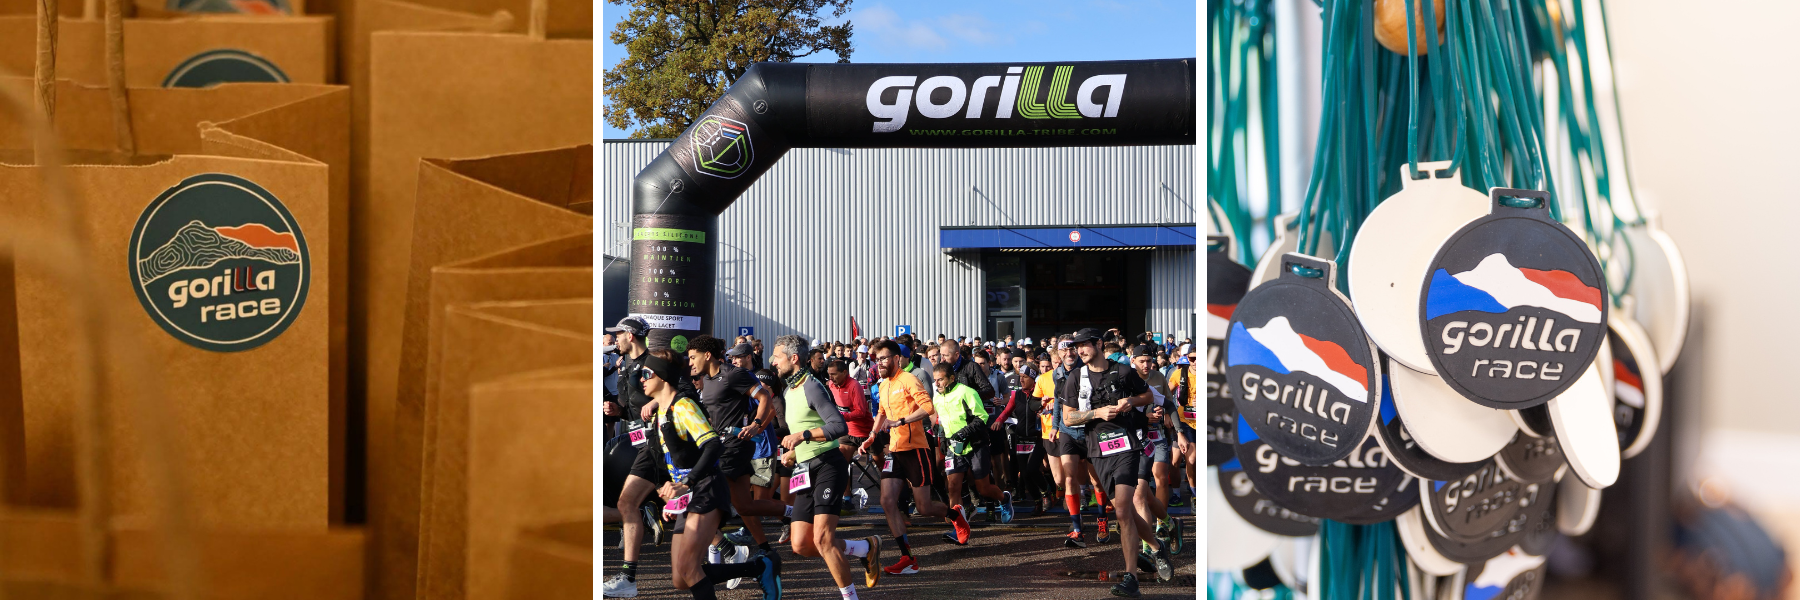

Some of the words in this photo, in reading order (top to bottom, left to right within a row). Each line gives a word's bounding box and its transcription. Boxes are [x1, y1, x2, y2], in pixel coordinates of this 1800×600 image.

[866, 66, 1127, 133] gorilla
[909, 128, 1117, 137] WWW.GORILLA-TRIBE.COM
[663, 231, 698, 240] SILICONE
[643, 254, 691, 262] MAINTIEN
[168, 265, 275, 308] gorilla
[642, 277, 686, 285] CONFORT
[632, 299, 695, 308] COMPRESSION
[201, 298, 281, 323] race
[741, 328, 749, 336] P
[898, 326, 906, 337] P
[1442, 315, 1582, 355] gorilla
[1471, 358, 1564, 381] race
[1241, 371, 1352, 425] gorilla
[1266, 411, 1339, 448] race
[1107, 439, 1121, 450] 65
[792, 475, 805, 488] 174
[1287, 475, 1378, 493] race
